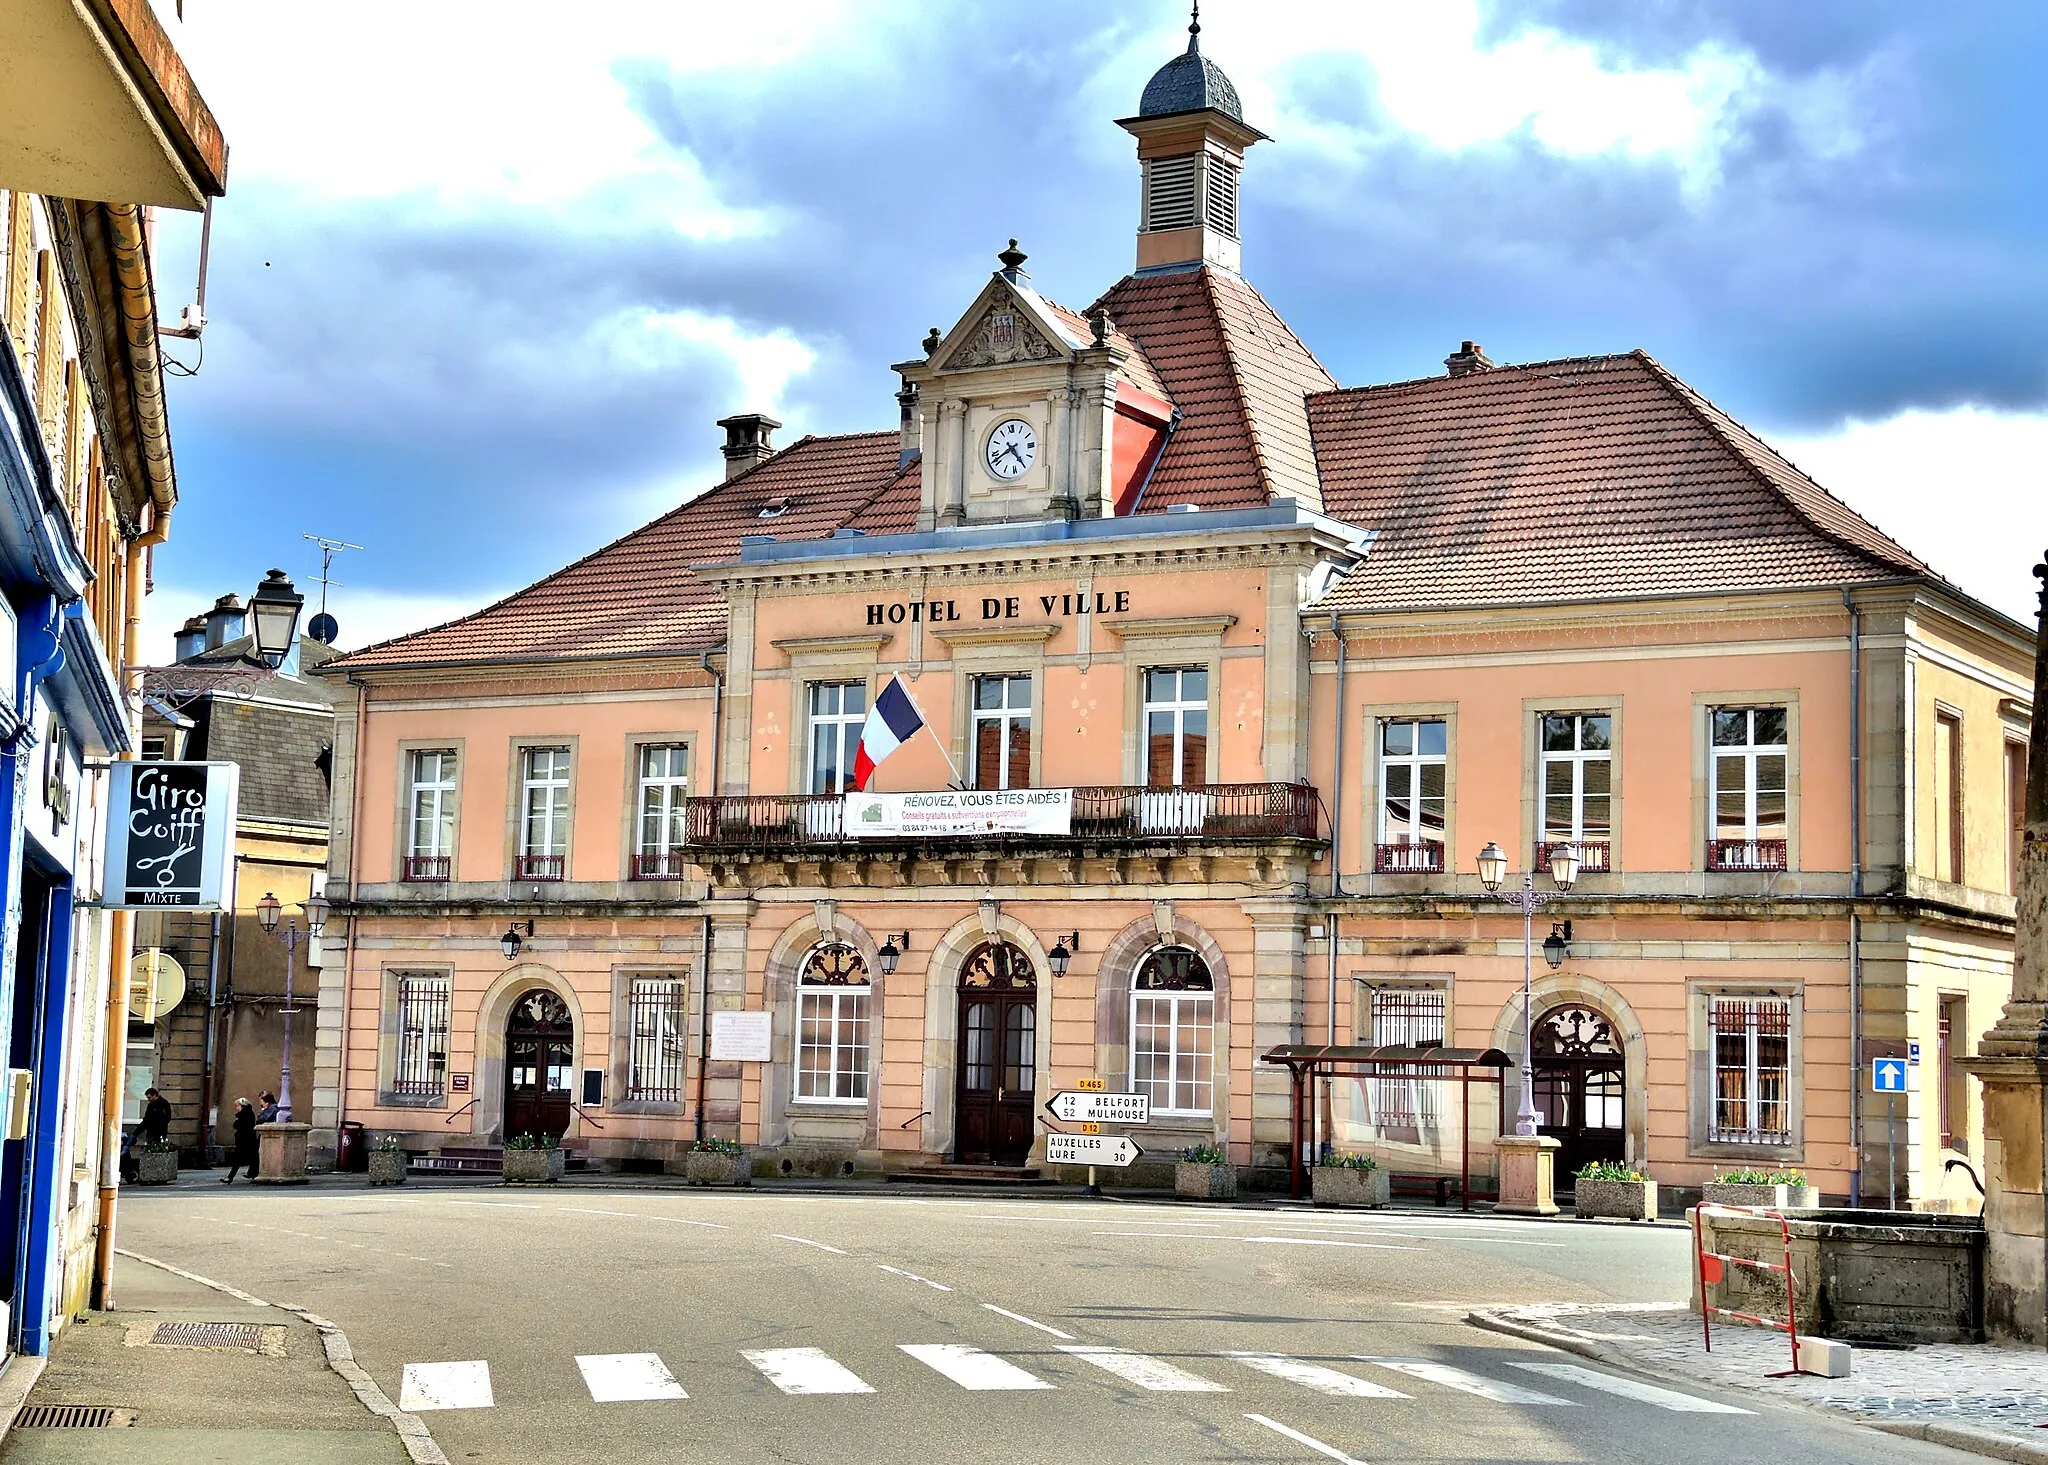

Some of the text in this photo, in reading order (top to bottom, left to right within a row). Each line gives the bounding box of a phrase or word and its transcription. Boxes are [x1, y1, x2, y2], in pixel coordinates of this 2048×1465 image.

[866, 591, 1130, 625] HOTEL DE VILLE
[136, 768, 204, 810] Giro
[903, 794, 957, 808] RÉNOVEZ,
[960, 794, 993, 806] VOUS
[995, 791, 1025, 805] ÊTES
[901, 811, 924, 820] Conseils
[925, 811, 947, 821] gratuits
[143, 892, 182, 904] MIXTE
[1064, 1096, 1145, 1108] 12 BELFORT
[1063, 1108, 1145, 1120] 52 MULHOUSE
[1083, 1124, 1088, 1132] D
[1050, 1138, 1126, 1149] AUXELLES 4
[1050, 1150, 1126, 1162] LURE 30
